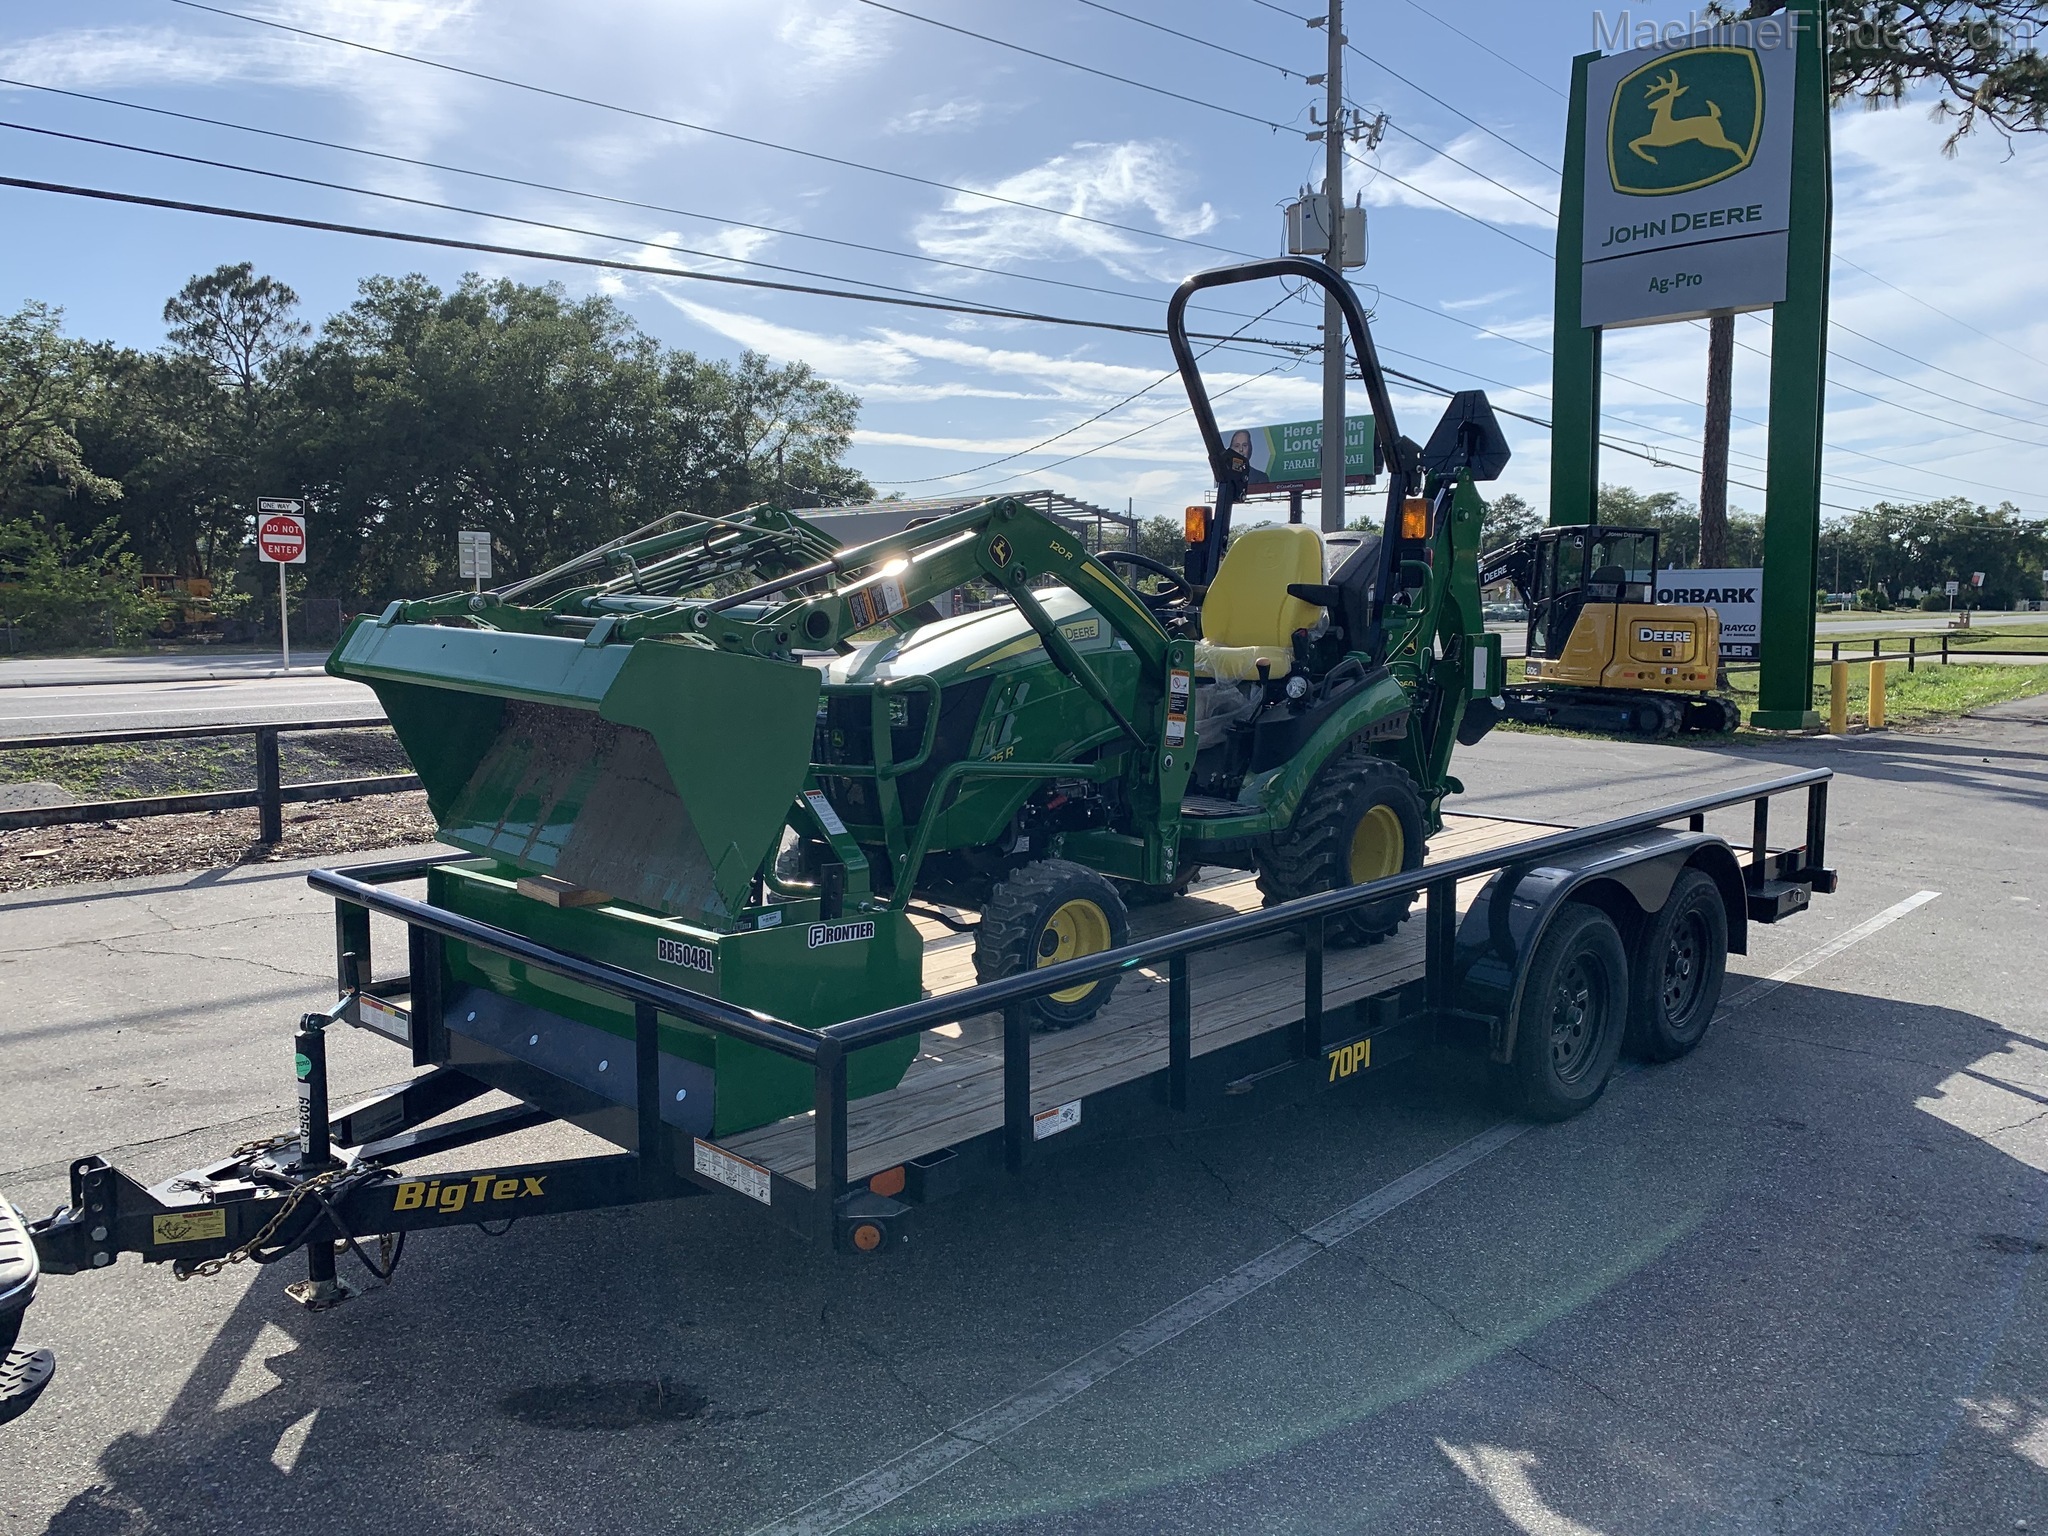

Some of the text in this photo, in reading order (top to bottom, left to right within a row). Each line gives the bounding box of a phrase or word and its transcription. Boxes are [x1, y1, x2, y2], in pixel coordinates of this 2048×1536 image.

[1602, 204, 1763, 247] JOHN DEERE
[1648, 272, 1703, 294] Ag-Pro
[1284, 425, 1313, 438] Here
[1284, 438, 1323, 453] Long
[1283, 458, 1316, 470] FARAH
[266, 524, 300, 534] DO NOT
[268, 545, 298, 554] ENTER
[1484, 564, 1508, 583] DEERE
[1657, 588, 1757, 604] ORBARK
[1065, 626, 1096, 640] DEERE
[1639, 628, 1692, 643] DEERE
[1724, 624, 1756, 632] RAYCO
[809, 922, 874, 947] FRONTIER
[658, 938, 714, 973] BB5048L
[1328, 1038, 1371, 1083] 70PI
